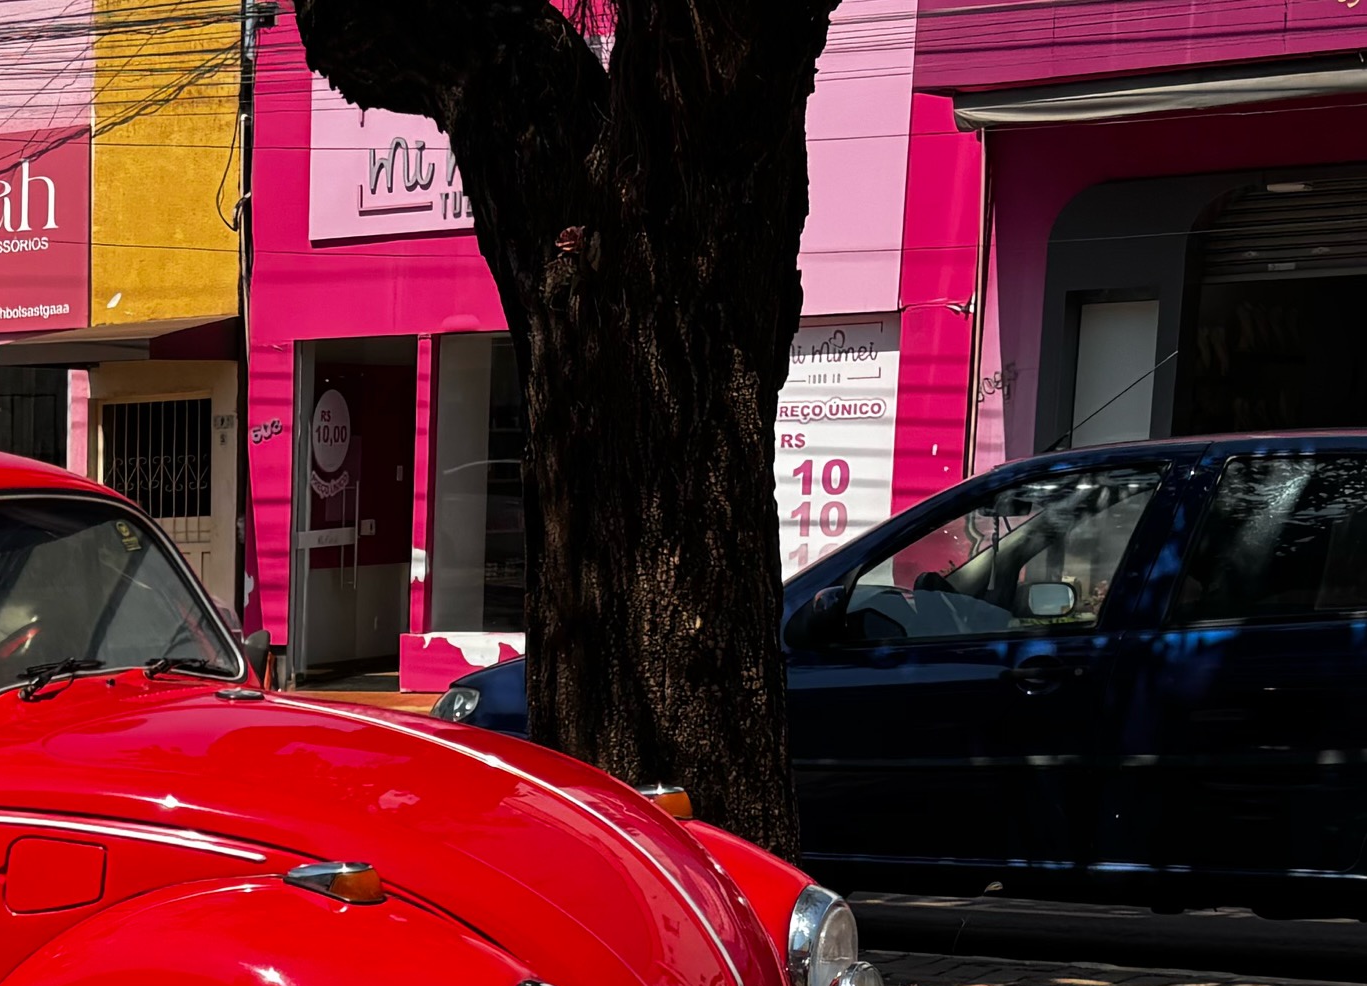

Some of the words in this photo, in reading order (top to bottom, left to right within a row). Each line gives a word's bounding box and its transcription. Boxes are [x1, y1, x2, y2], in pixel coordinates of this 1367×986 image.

[779, 404, 823, 420] REÇO
[828, 401, 882, 416] ÚNICO
[315, 425, 348, 446] 10,00
[792, 458, 850, 496] 10
[790, 501, 848, 538] 10
